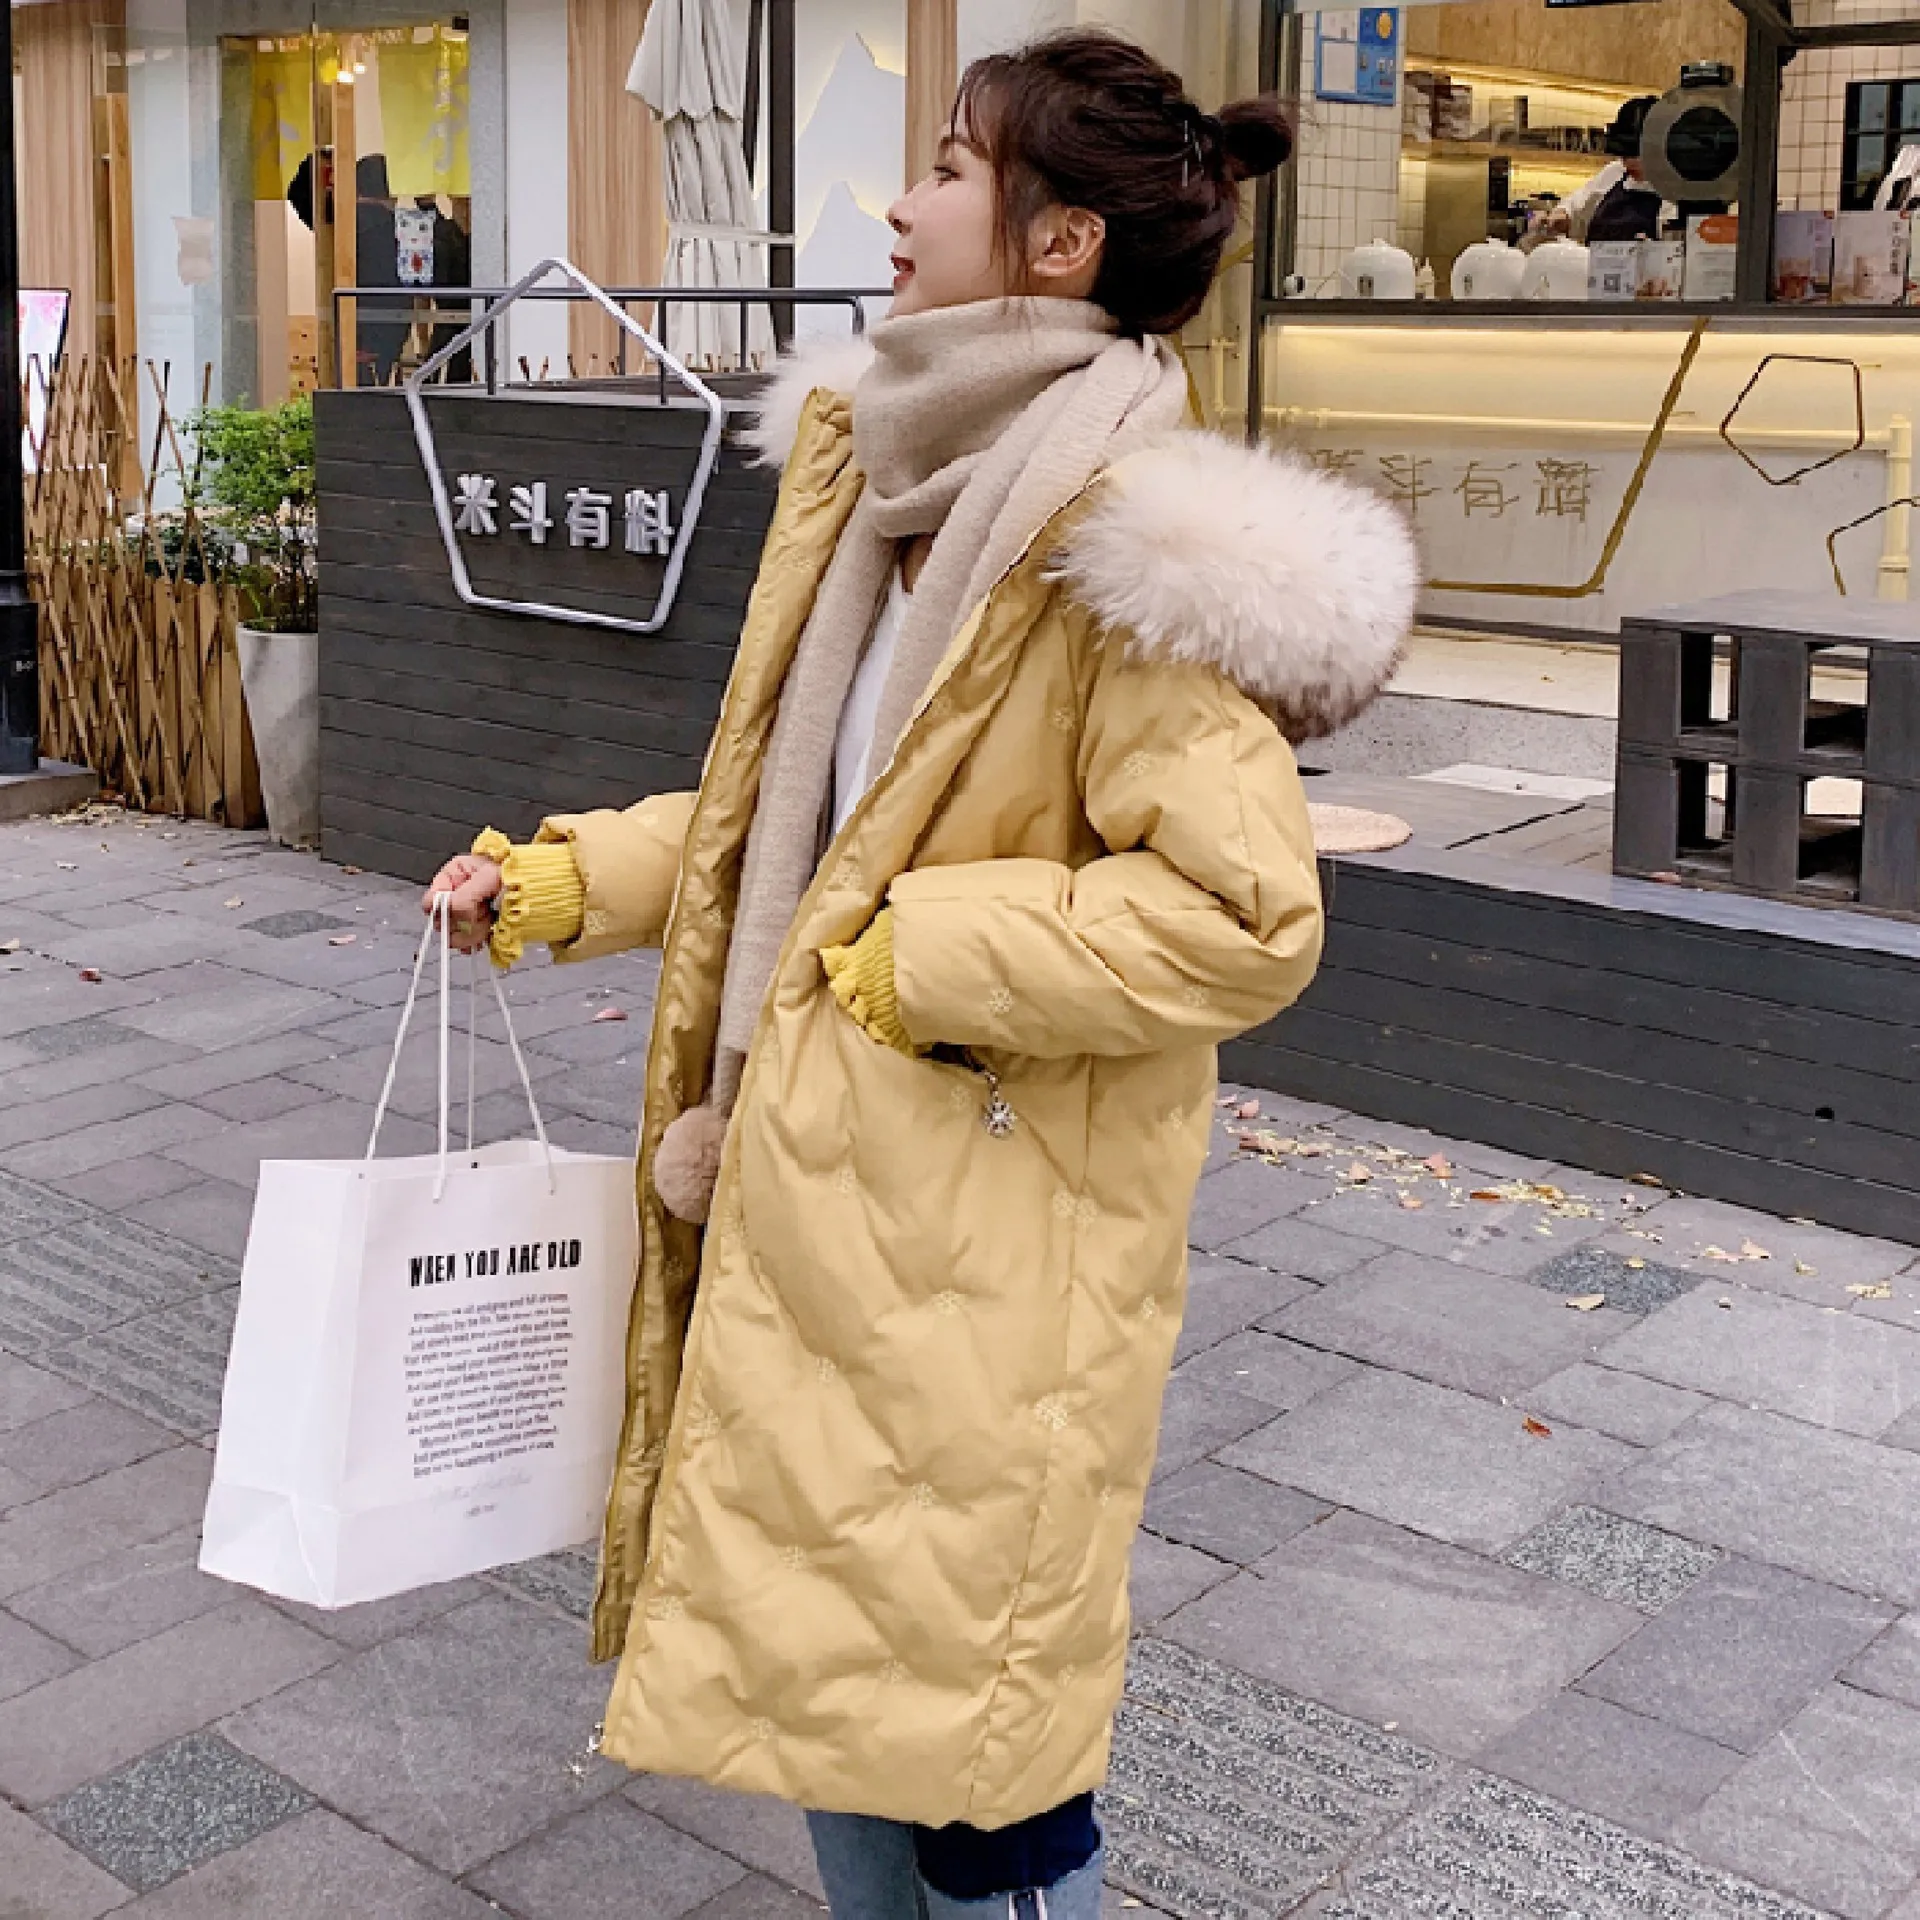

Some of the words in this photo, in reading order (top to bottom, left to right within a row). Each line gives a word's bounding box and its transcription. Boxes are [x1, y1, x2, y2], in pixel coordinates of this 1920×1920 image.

[453, 474, 675, 556] 米斗有料
[409, 1255, 456, 1287] WHEN
[465, 1248, 500, 1278] YOU
[507, 1243, 542, 1275] ARE
[547, 1239, 582, 1270] OLD
